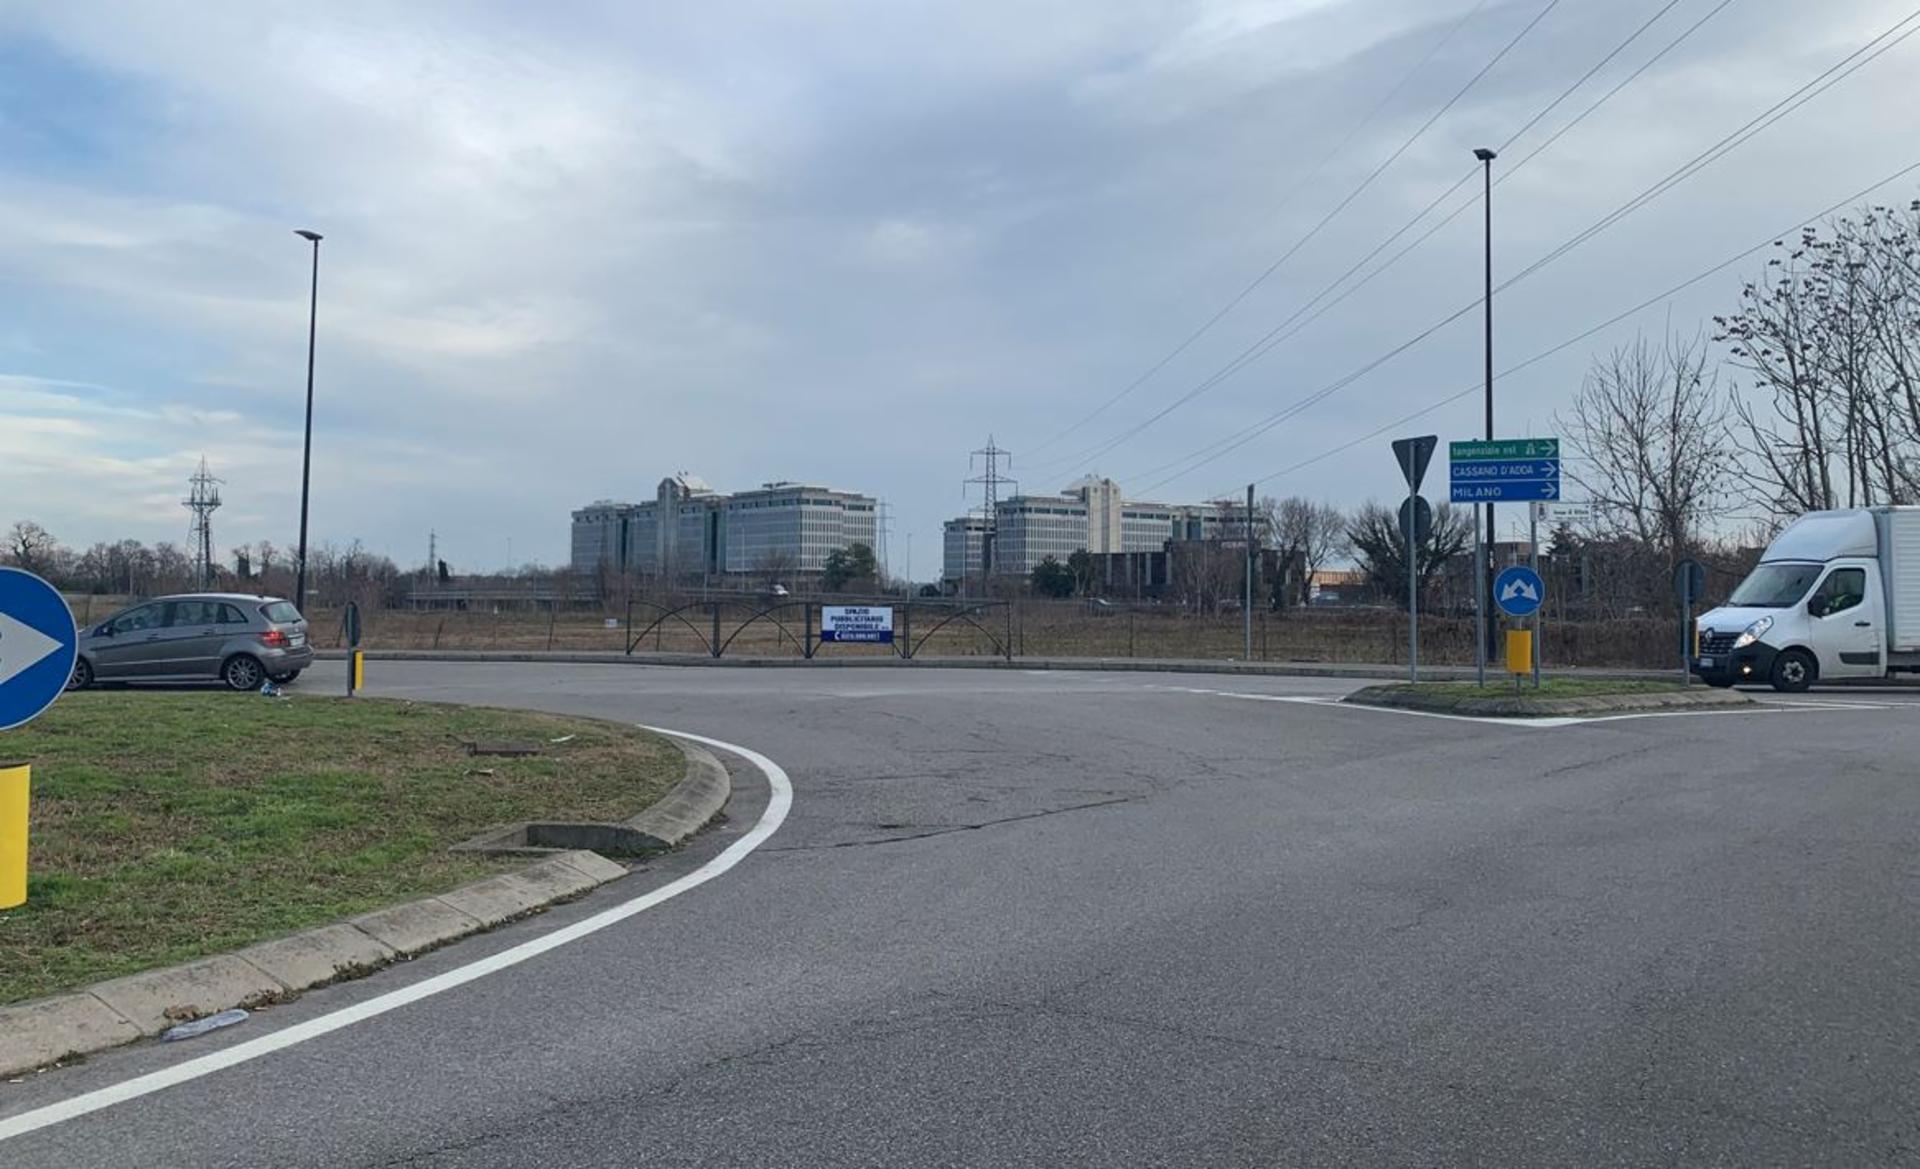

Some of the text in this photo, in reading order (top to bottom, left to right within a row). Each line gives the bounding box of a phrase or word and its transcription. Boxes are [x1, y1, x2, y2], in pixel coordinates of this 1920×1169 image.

[1452, 445, 1517, 457] tangenziale est
[1452, 465, 1534, 476] CASSANO D'ADDA
[1452, 487, 1502, 497] MILANO
